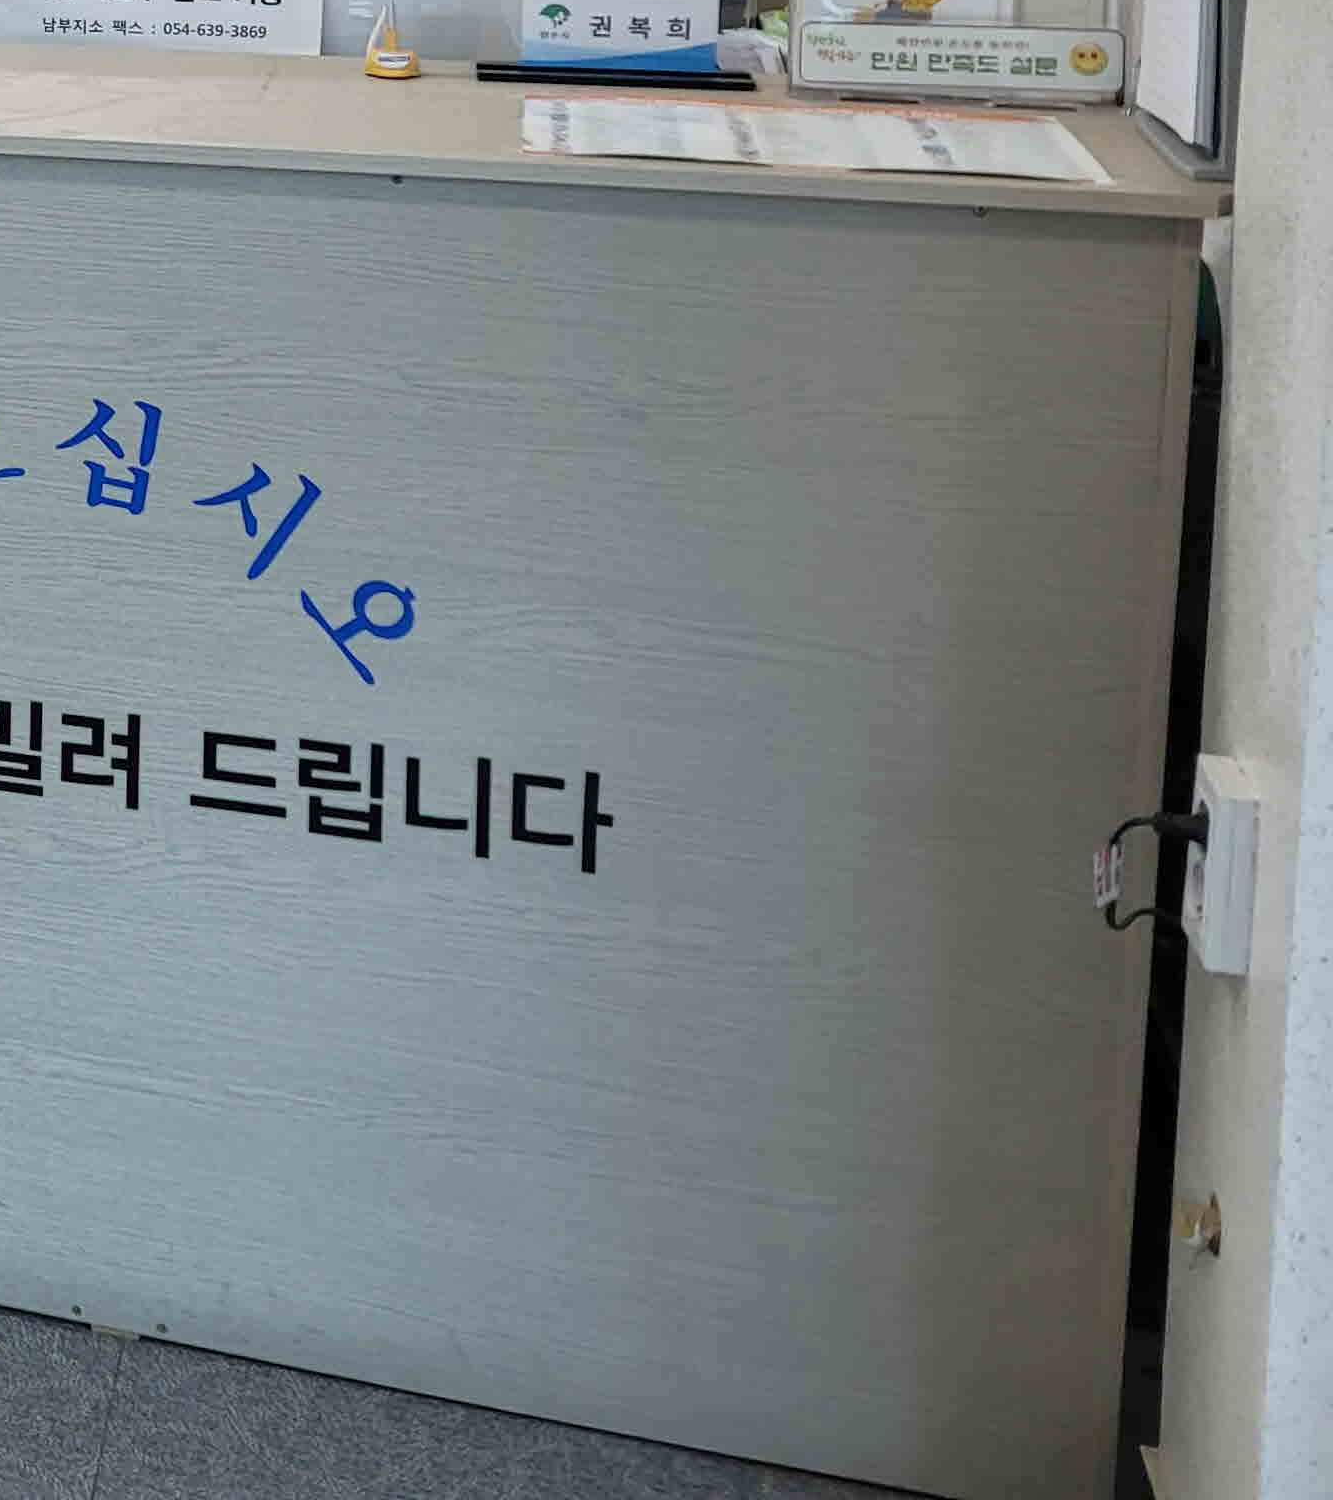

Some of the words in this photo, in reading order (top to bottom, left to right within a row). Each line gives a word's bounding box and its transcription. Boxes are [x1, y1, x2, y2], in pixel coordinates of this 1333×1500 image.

[43, 18, 104, 34] 남부지소
[112, 20, 143, 35] 팩스
[164, 23, 267, 38] 054-639-3869
[870, 52, 918, 72] 민원
[190, 732, 613, 874] 드립니다
